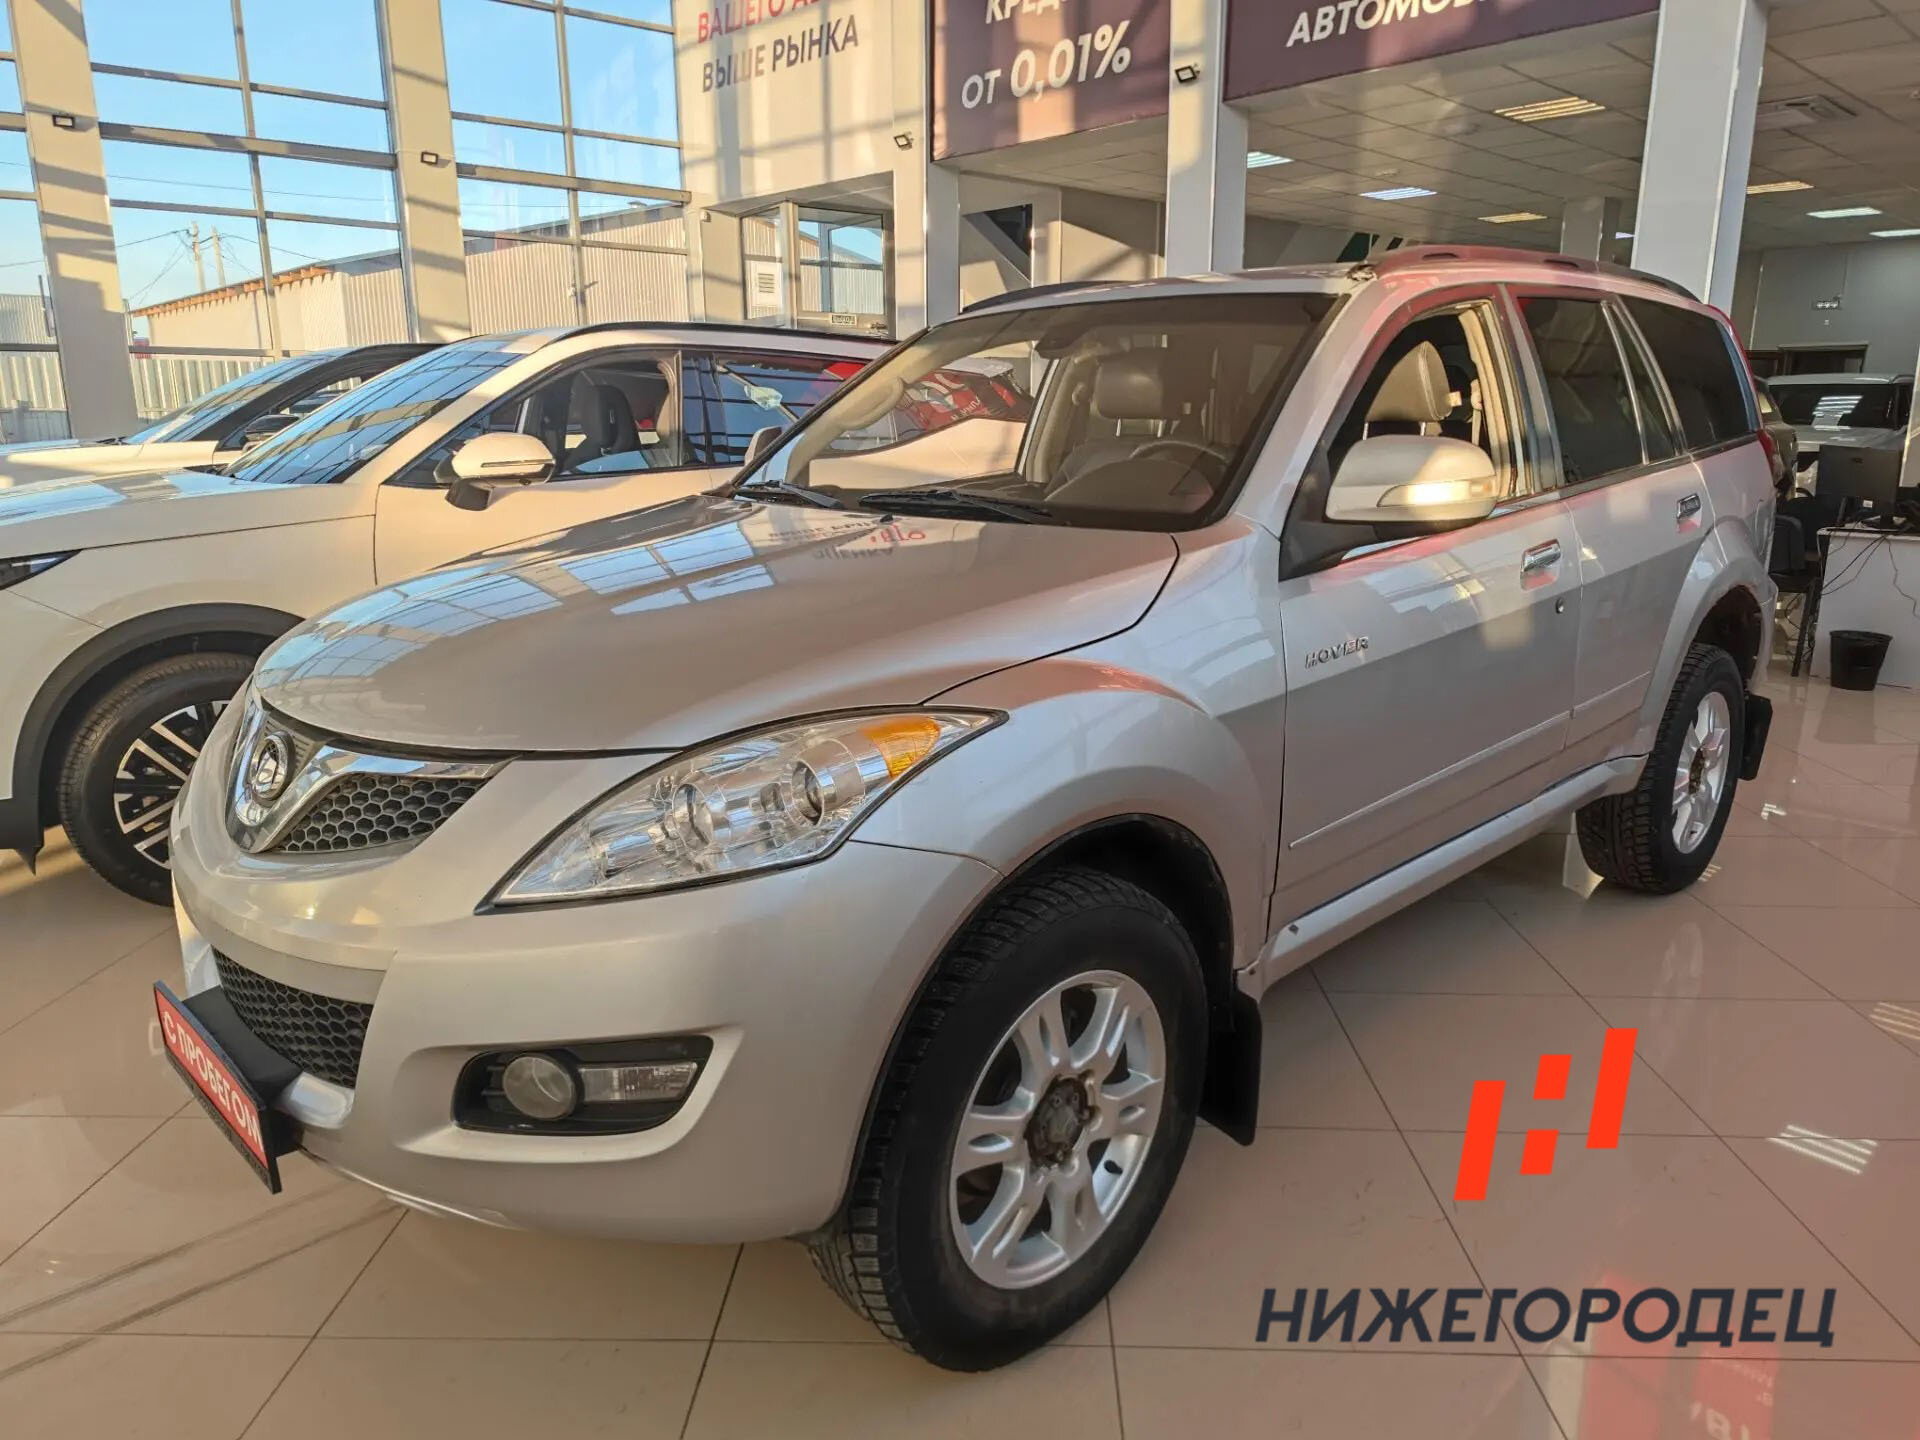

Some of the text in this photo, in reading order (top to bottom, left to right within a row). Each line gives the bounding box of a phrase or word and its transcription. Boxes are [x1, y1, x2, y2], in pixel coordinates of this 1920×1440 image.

[703, 14, 859, 92] ВЫШЕ РЫНКА
[962, 20, 1132, 109] ОТ 0,01%
[1305, 637, 1369, 669] HOVER
[163, 1011, 176, 1044] С
[177, 1024, 265, 1152] ПРОБЕГОМ
